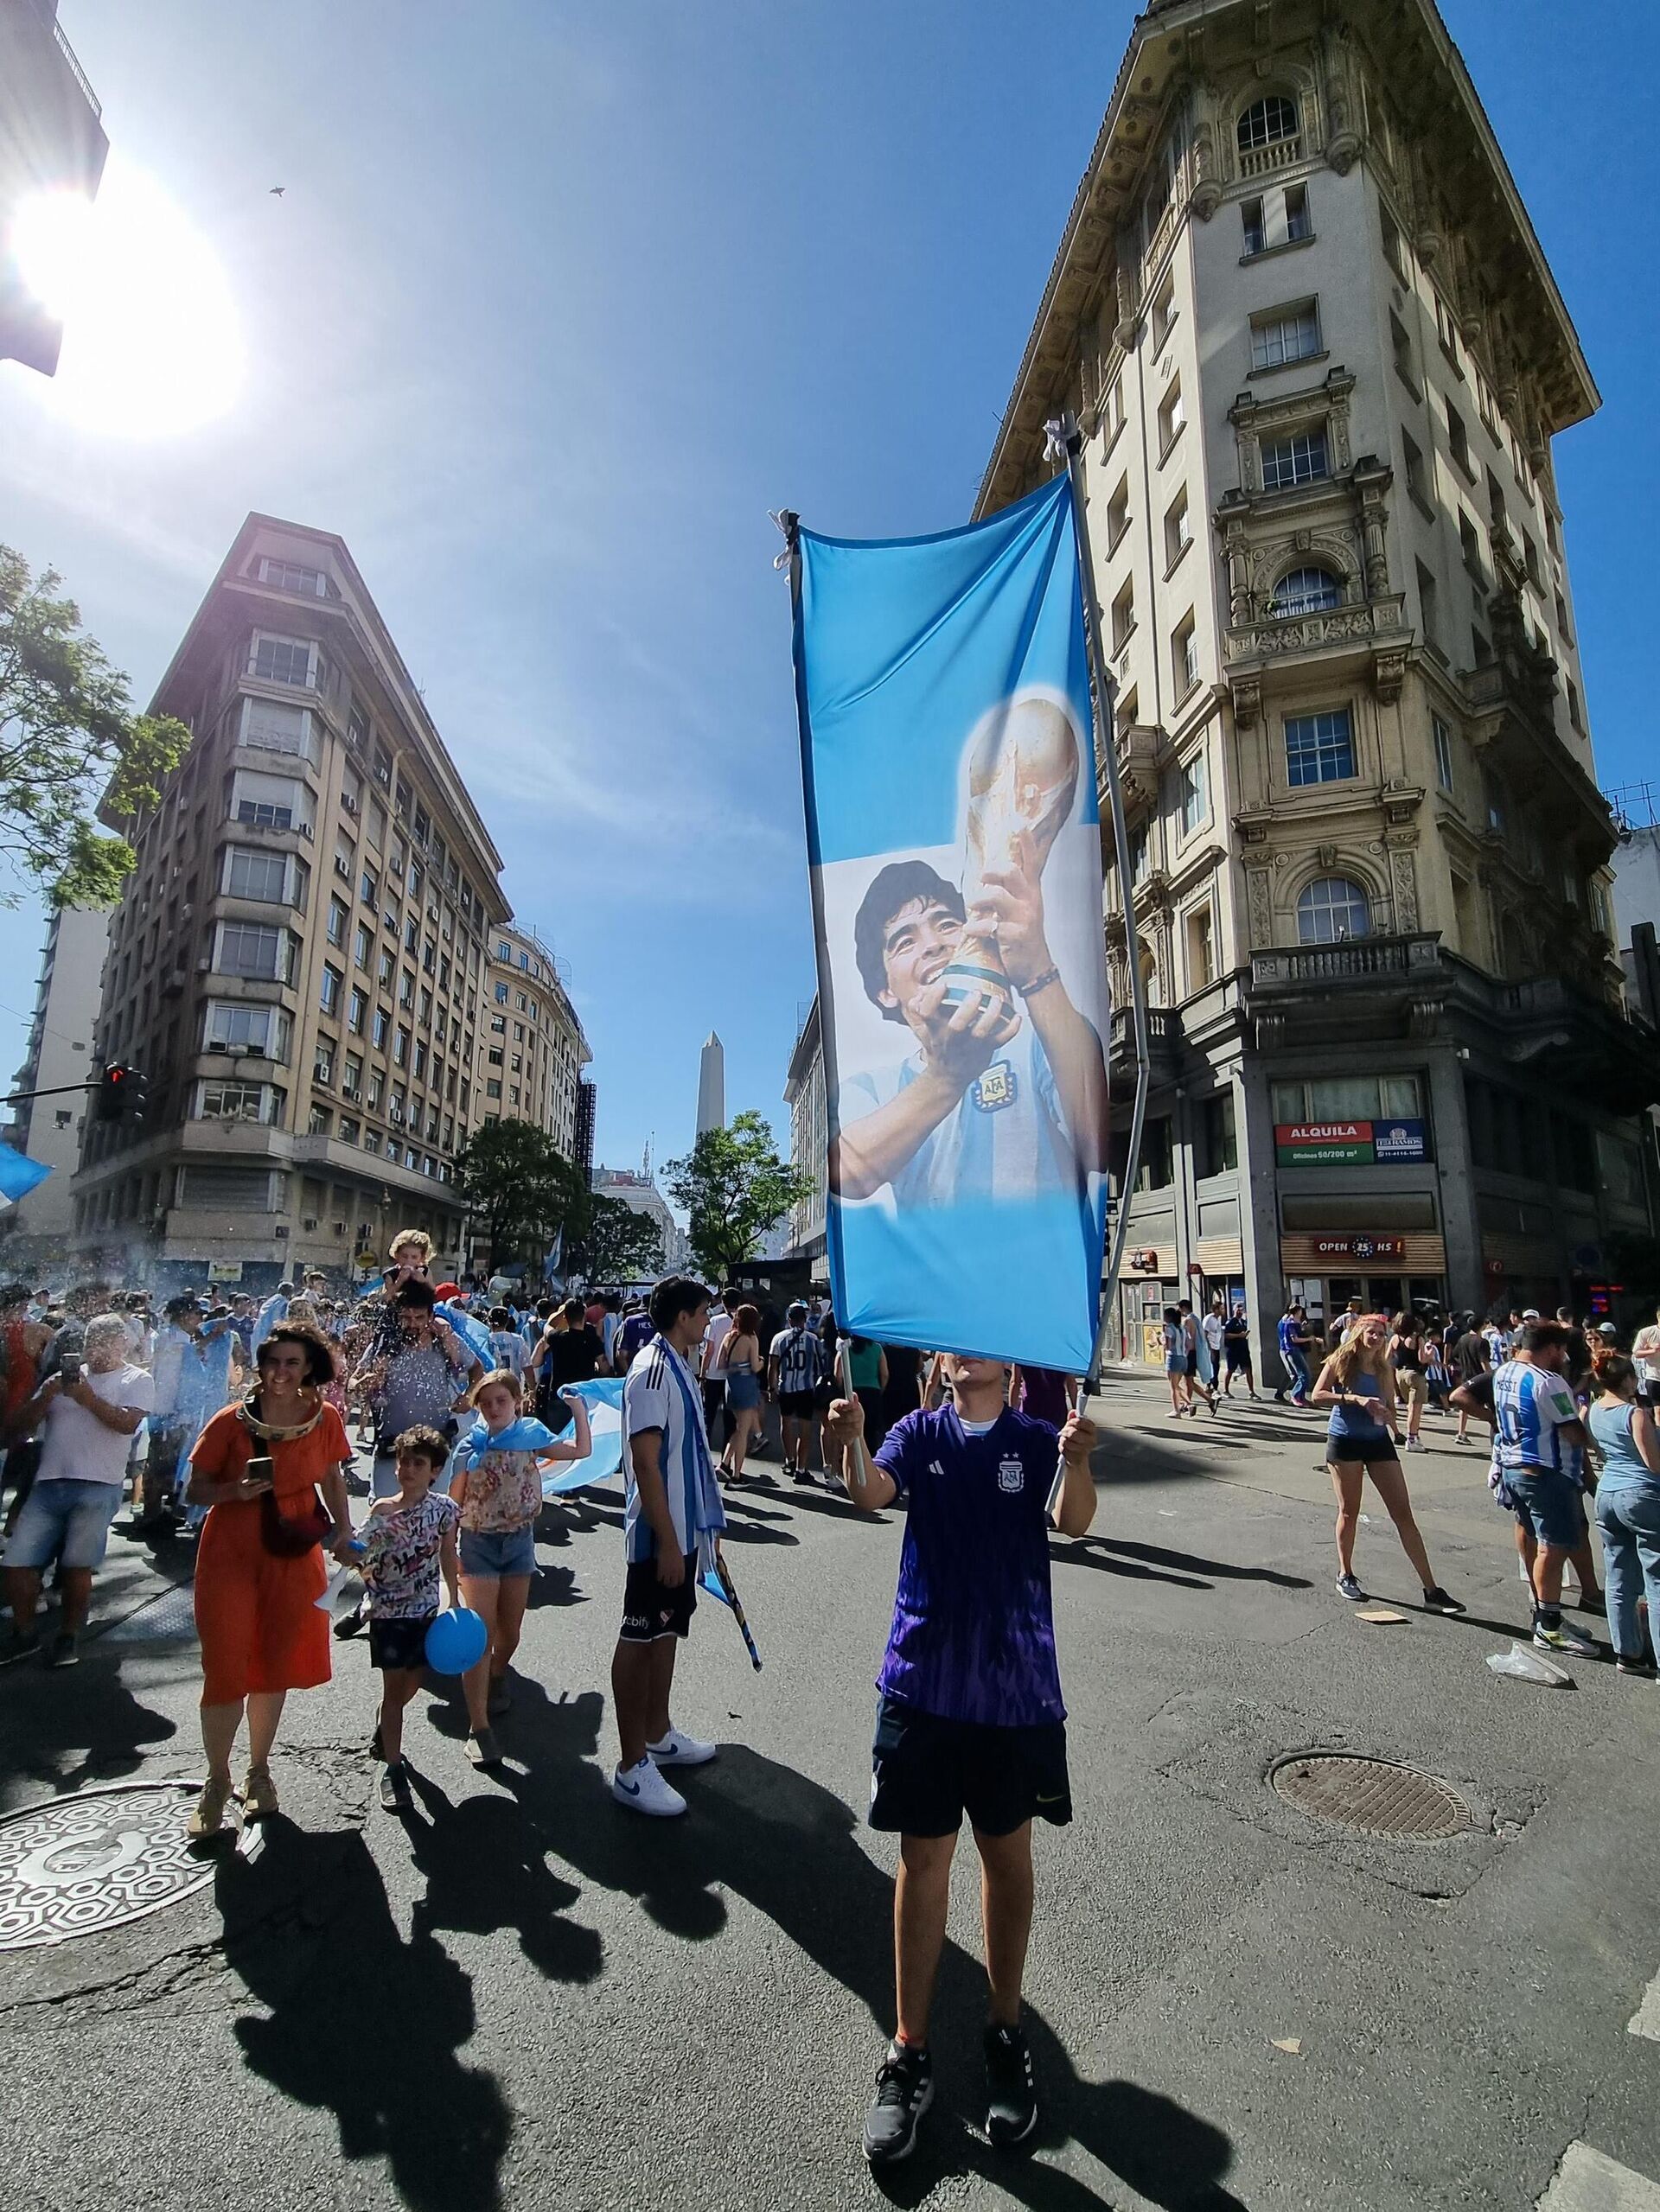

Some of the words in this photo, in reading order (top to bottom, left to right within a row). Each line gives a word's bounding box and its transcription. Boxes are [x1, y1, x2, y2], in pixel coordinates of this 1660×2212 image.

[1291, 1125, 1357, 1138] ALQUILA
[1319, 1242, 1348, 1252] OPEN
[1377, 1242, 1392, 1252] HS
[785, 1349, 806, 1371] 10
